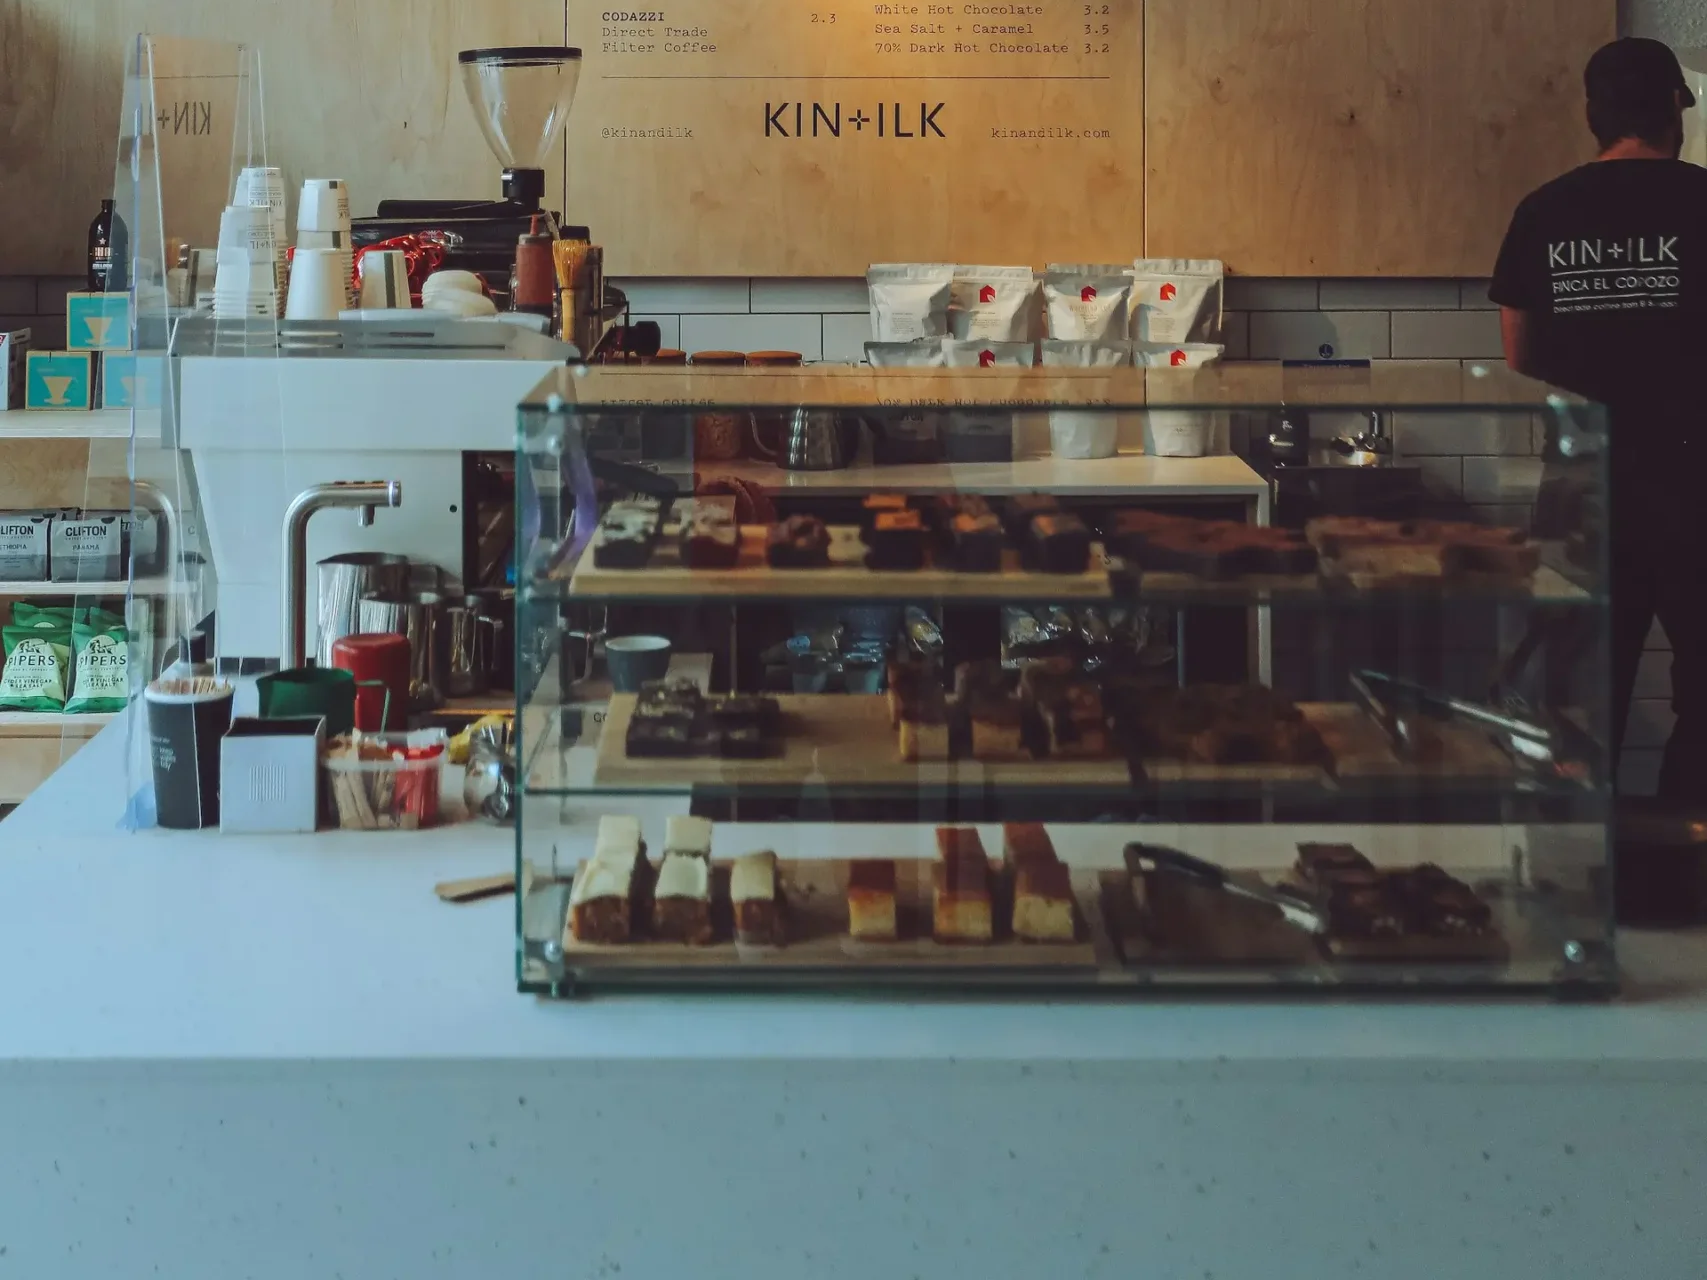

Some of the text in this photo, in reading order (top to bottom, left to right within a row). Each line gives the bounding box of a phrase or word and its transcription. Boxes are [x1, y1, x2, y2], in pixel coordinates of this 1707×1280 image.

[875, 5, 1042, 14] White Hot Chocolate
[1084, 5, 1109, 15] 3.2
[602, 12, 664, 21] CODAZZI
[811, 14, 835, 24] 2.3
[602, 27, 707, 37] Direct Trade
[875, 24, 901, 33] Sea
[911, 24, 944, 33] Salt
[973, 24, 1033, 34] Caramel
[1084, 24, 1109, 35] 3.5
[603, 42, 716, 52] Filter Coffee
[875, 43, 1068, 53] 70% Dark Hot Chocolate
[1085, 43, 1109, 54] 3.2
[765, 102, 946, 138] KIN+ILK
[602, 128, 693, 138] @kinandilk
[992, 128, 1110, 138] kinandilk.com
[1548, 236, 1679, 268] KIN+ILK
[1593, 277, 1610, 290] EL
[0, 525, 34, 536] LIFTON
[65, 525, 107, 537] CLIFTON
